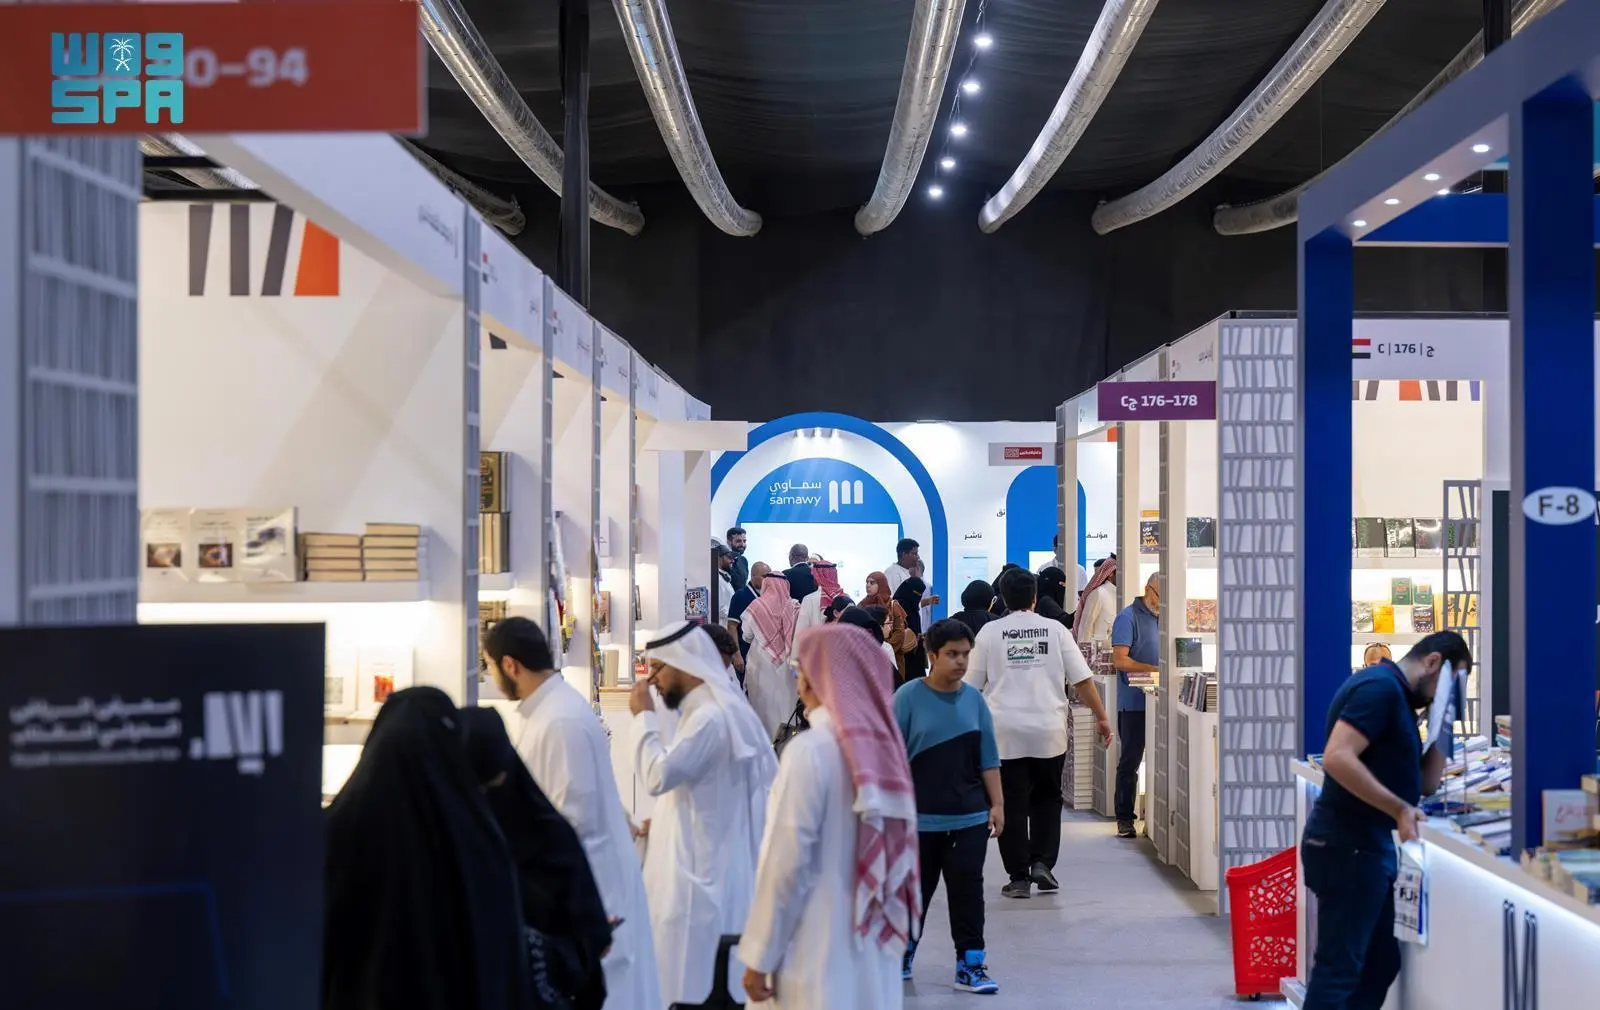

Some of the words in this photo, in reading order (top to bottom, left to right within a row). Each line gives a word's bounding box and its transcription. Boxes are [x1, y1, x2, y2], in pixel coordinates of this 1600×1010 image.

[1378, 343, 1385, 354] C
[1394, 343, 1416, 354] 176
[1426, 346, 1435, 358] ج
[769, 495, 822, 507] samawy
[1537, 494, 1580, 517] F-8
[964, 530, 983, 541] ناشر
[1002, 628, 1049, 640] MOUNTAIN
